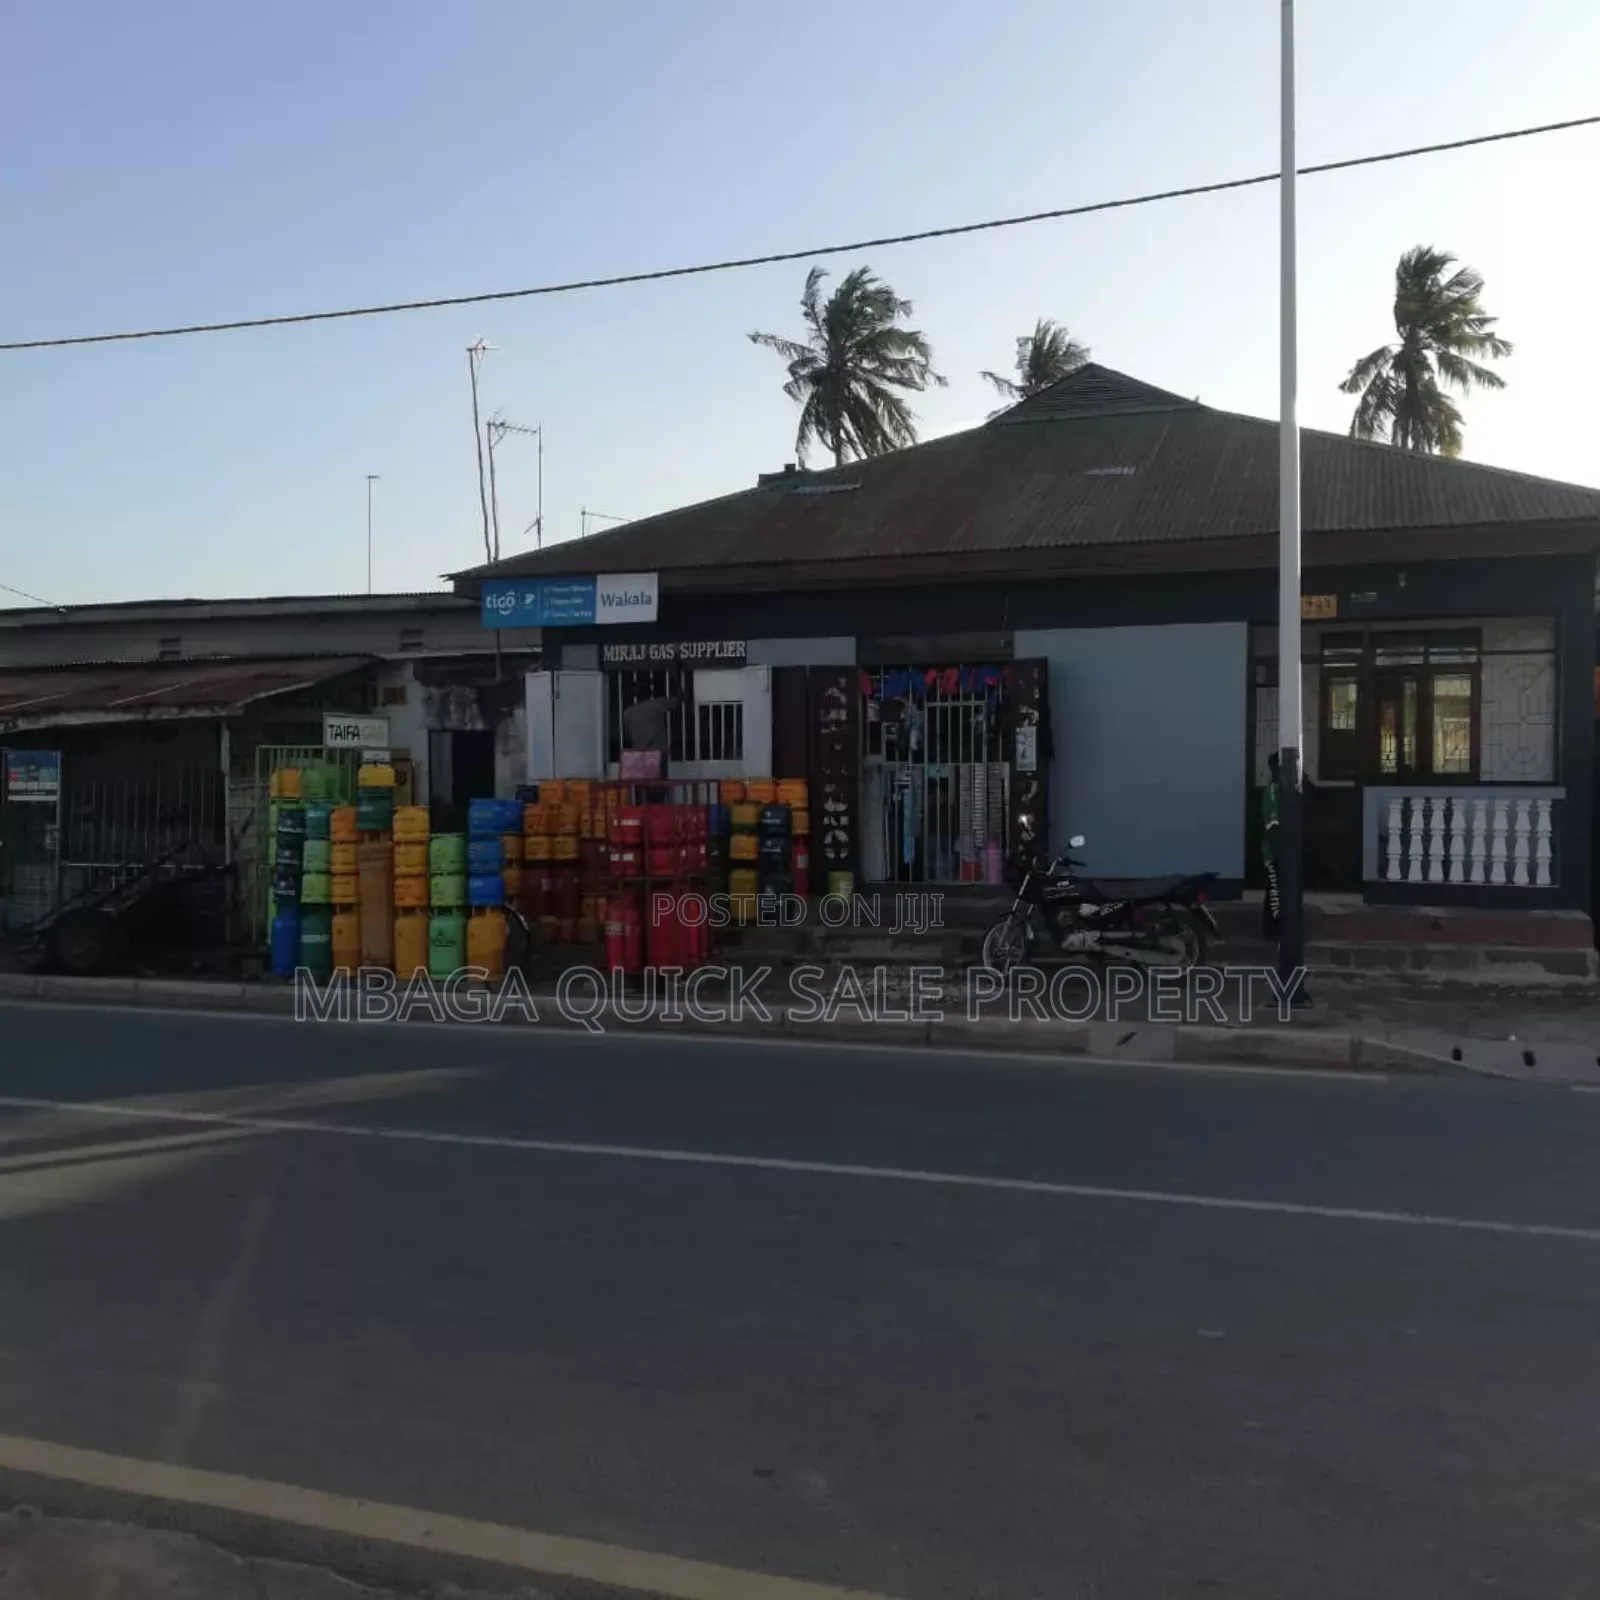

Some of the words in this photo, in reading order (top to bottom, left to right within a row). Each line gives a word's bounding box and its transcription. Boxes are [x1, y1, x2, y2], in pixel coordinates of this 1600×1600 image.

[601, 591, 653, 607] Wakala
[603, 644, 646, 662] MIRAJ
[650, 643, 675, 659] GAS
[679, 640, 746, 658] SUPPLIER
[327, 724, 361, 741] TAIFA
